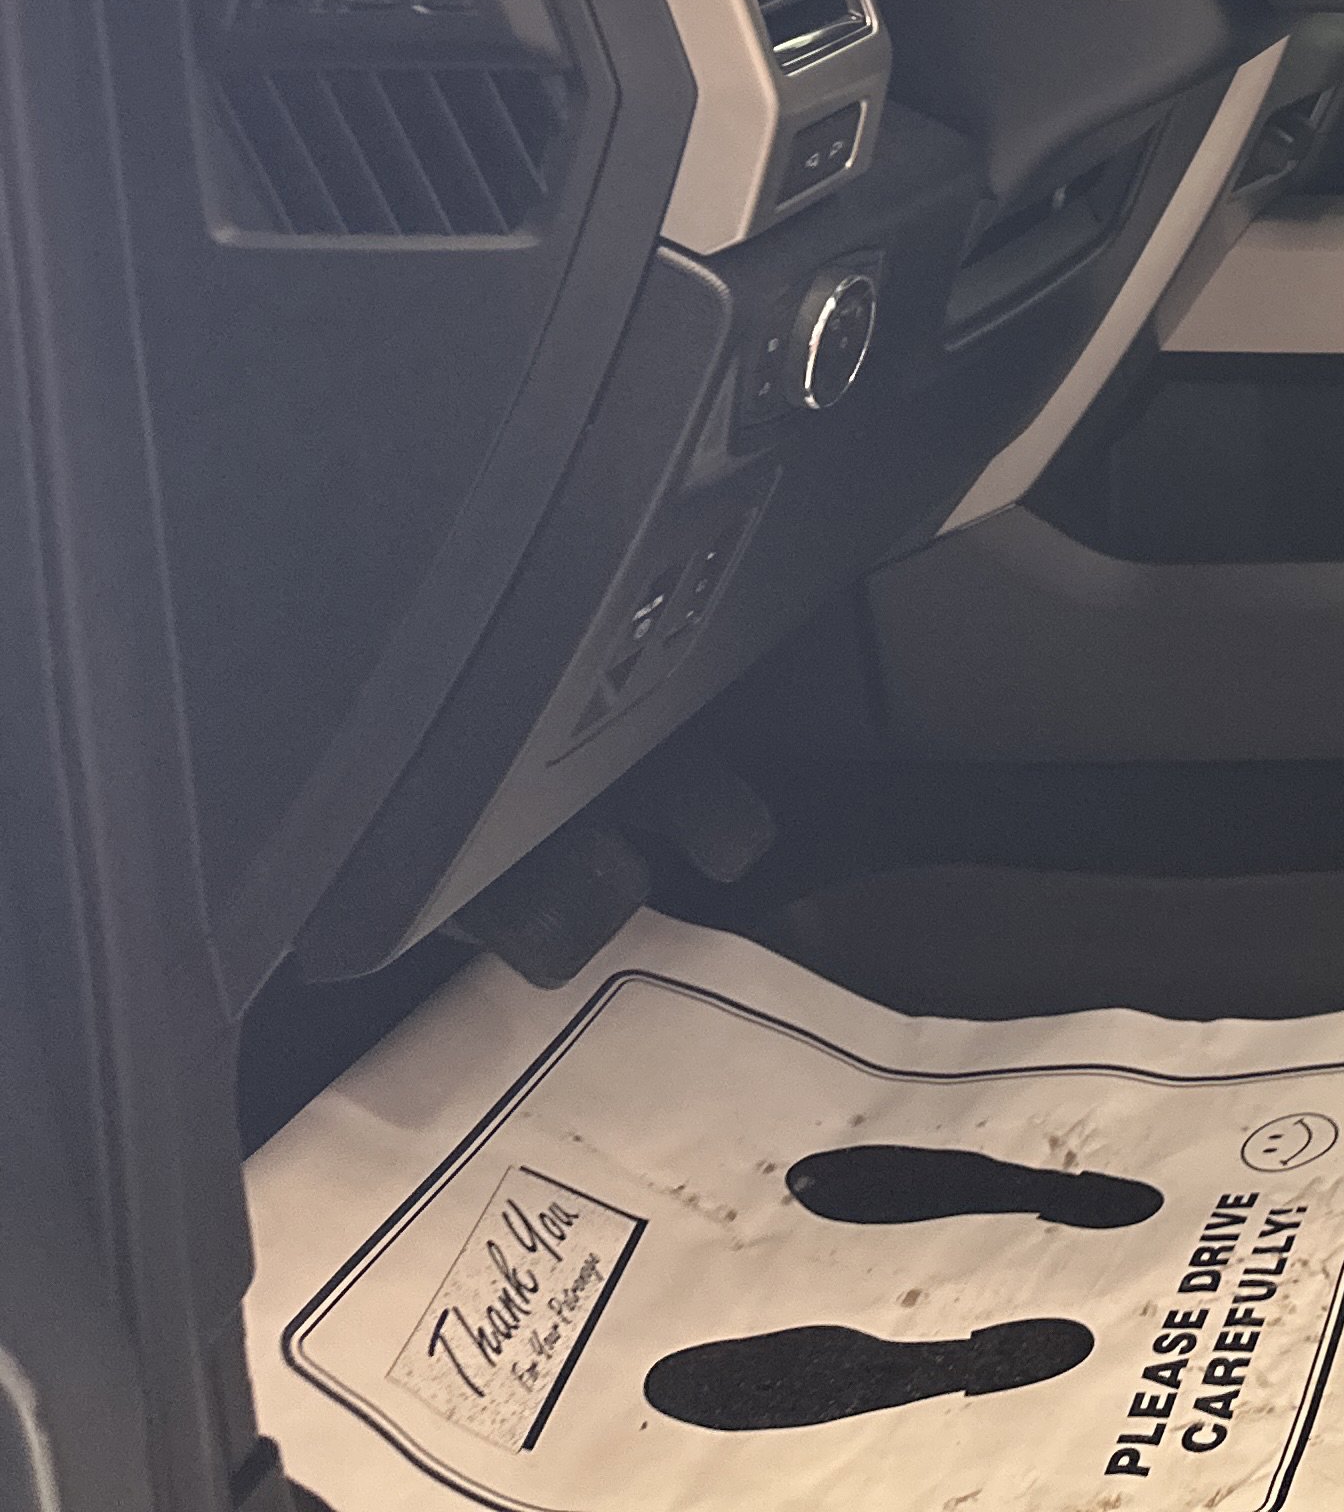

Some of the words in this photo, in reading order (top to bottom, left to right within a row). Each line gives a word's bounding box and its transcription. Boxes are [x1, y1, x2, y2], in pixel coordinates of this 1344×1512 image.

[428, 1240, 539, 1397] Thank
[502, 1198, 579, 1262] You
[1104, 1308, 1210, 1477] PLEASE
[1177, 1192, 1260, 1293] DRIVE
[1181, 1206, 1308, 1453] CAREFULLY!
